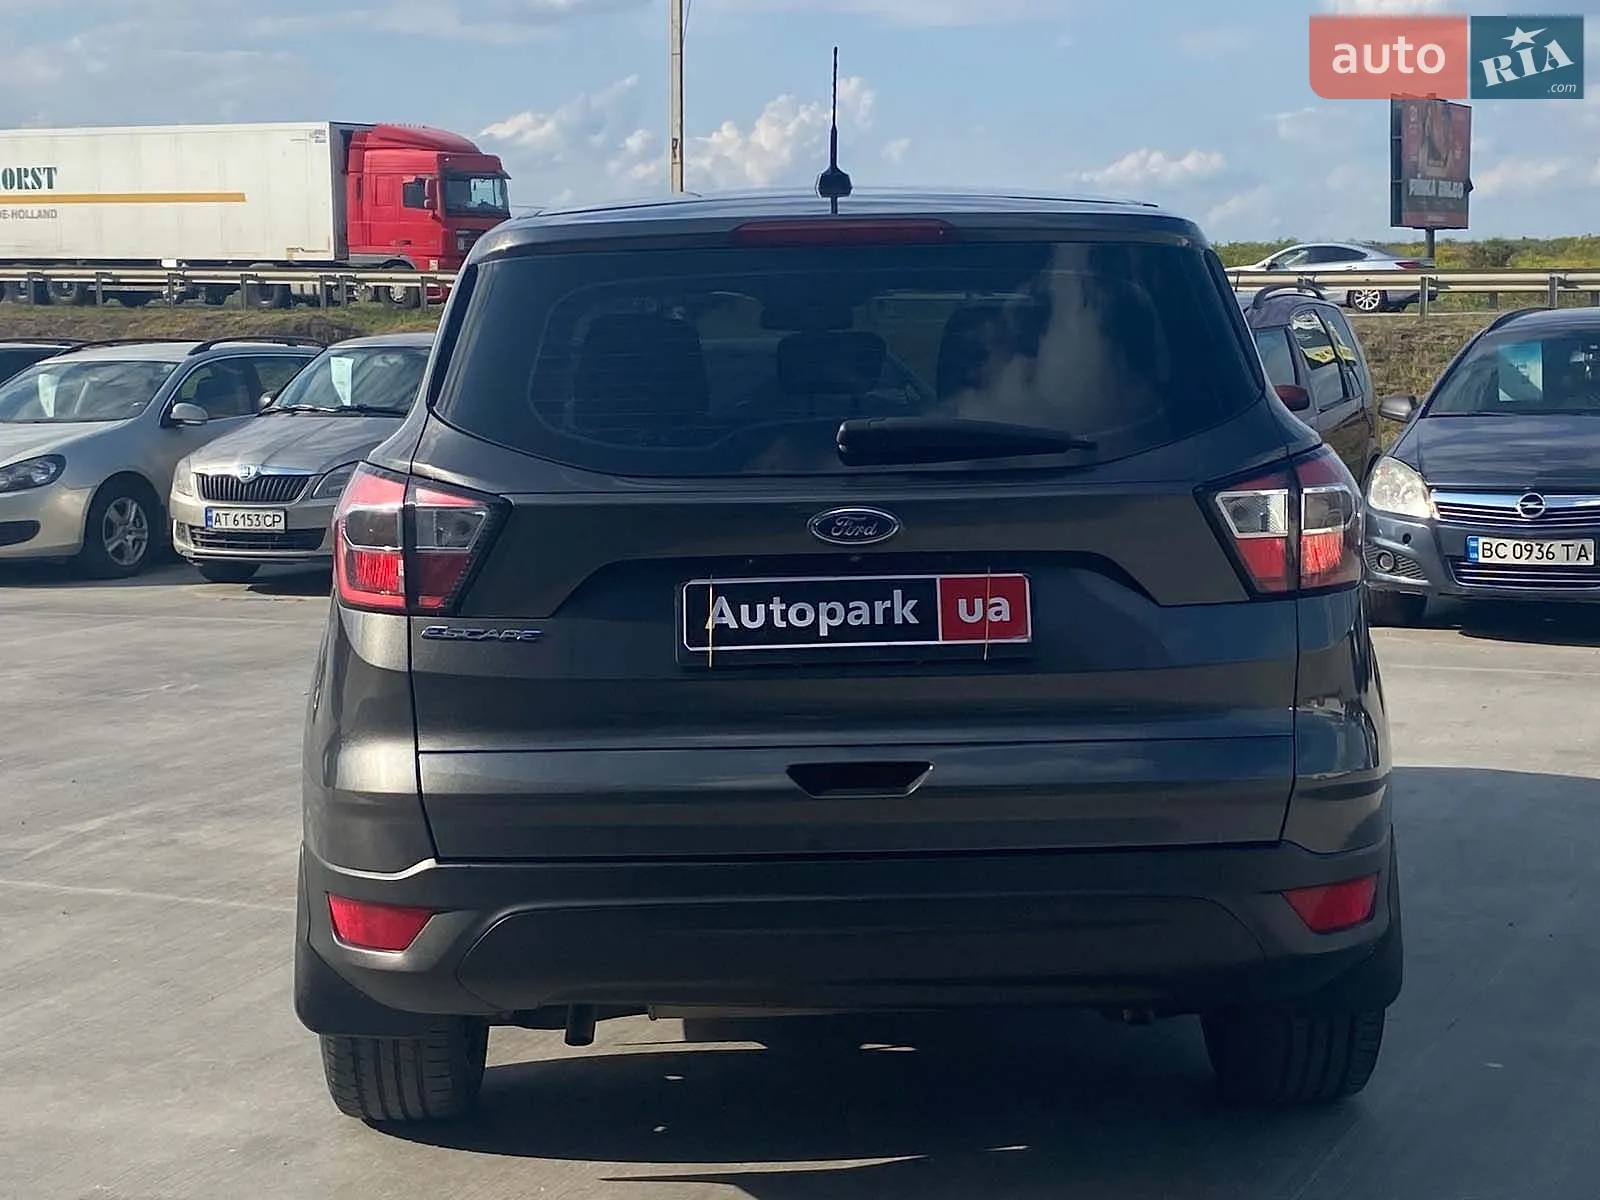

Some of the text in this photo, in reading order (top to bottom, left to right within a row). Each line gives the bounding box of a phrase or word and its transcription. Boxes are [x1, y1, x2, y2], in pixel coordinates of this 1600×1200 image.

[1, 167, 58, 190] ORST
[214, 512, 282, 527] AT 6153 CP
[831, 516, 879, 536] Ford
[1482, 542, 1589, 561] BC 0936 TA
[706, 590, 1010, 636] Autopark ua
[421, 625, 543, 640] ESCAPE
